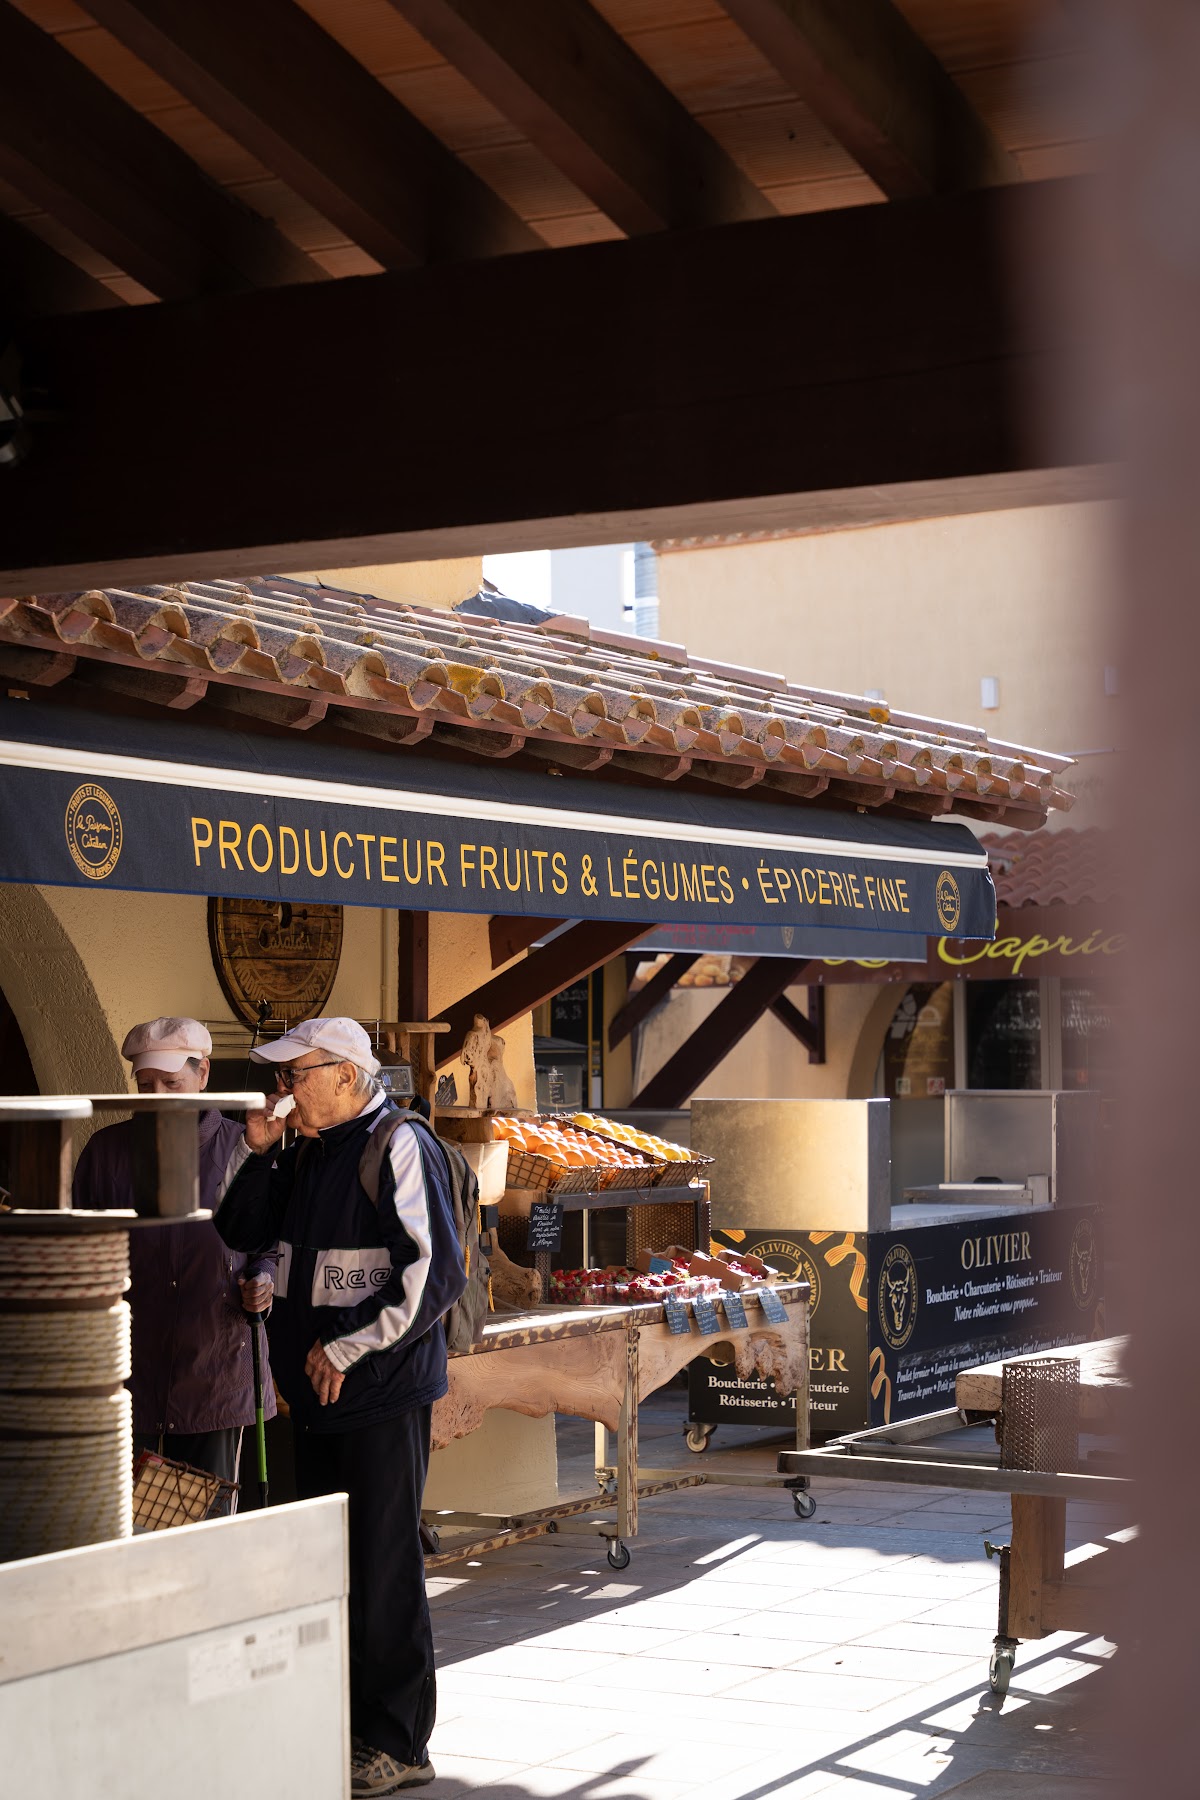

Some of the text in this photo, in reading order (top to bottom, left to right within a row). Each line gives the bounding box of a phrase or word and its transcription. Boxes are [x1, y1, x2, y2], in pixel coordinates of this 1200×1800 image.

[70, 791, 87, 812] FRUITS
[85, 787, 93, 797] ET
[191, 817, 448, 886] PRODUCTEUR
[460, 843, 568, 895] FRUITS
[580, 854, 599, 897] &
[607, 849, 735, 904] LÉGUMES
[757, 859, 864, 909] ÉPICERIE
[864, 876, 910, 913] FINE
[752, 1242, 802, 1261] OLIVIER
[960, 1231, 1032, 1270] OLIVIER
[925, 1268, 1063, 1305] Boucherie Charcuterie Rôtisserie Traiteur
[953, 1305, 972, 1322] Notre
[972, 1299, 999, 1319] rôtisserie
[708, 1376, 767, 1390] Boucherie
[896, 1368, 913, 1384] Poulet
[911, 1365, 931, 1384] fermier
[934, 1360, 950, 1377] Lapin
[719, 1394, 838, 1411] Rôtisserie Titeur
